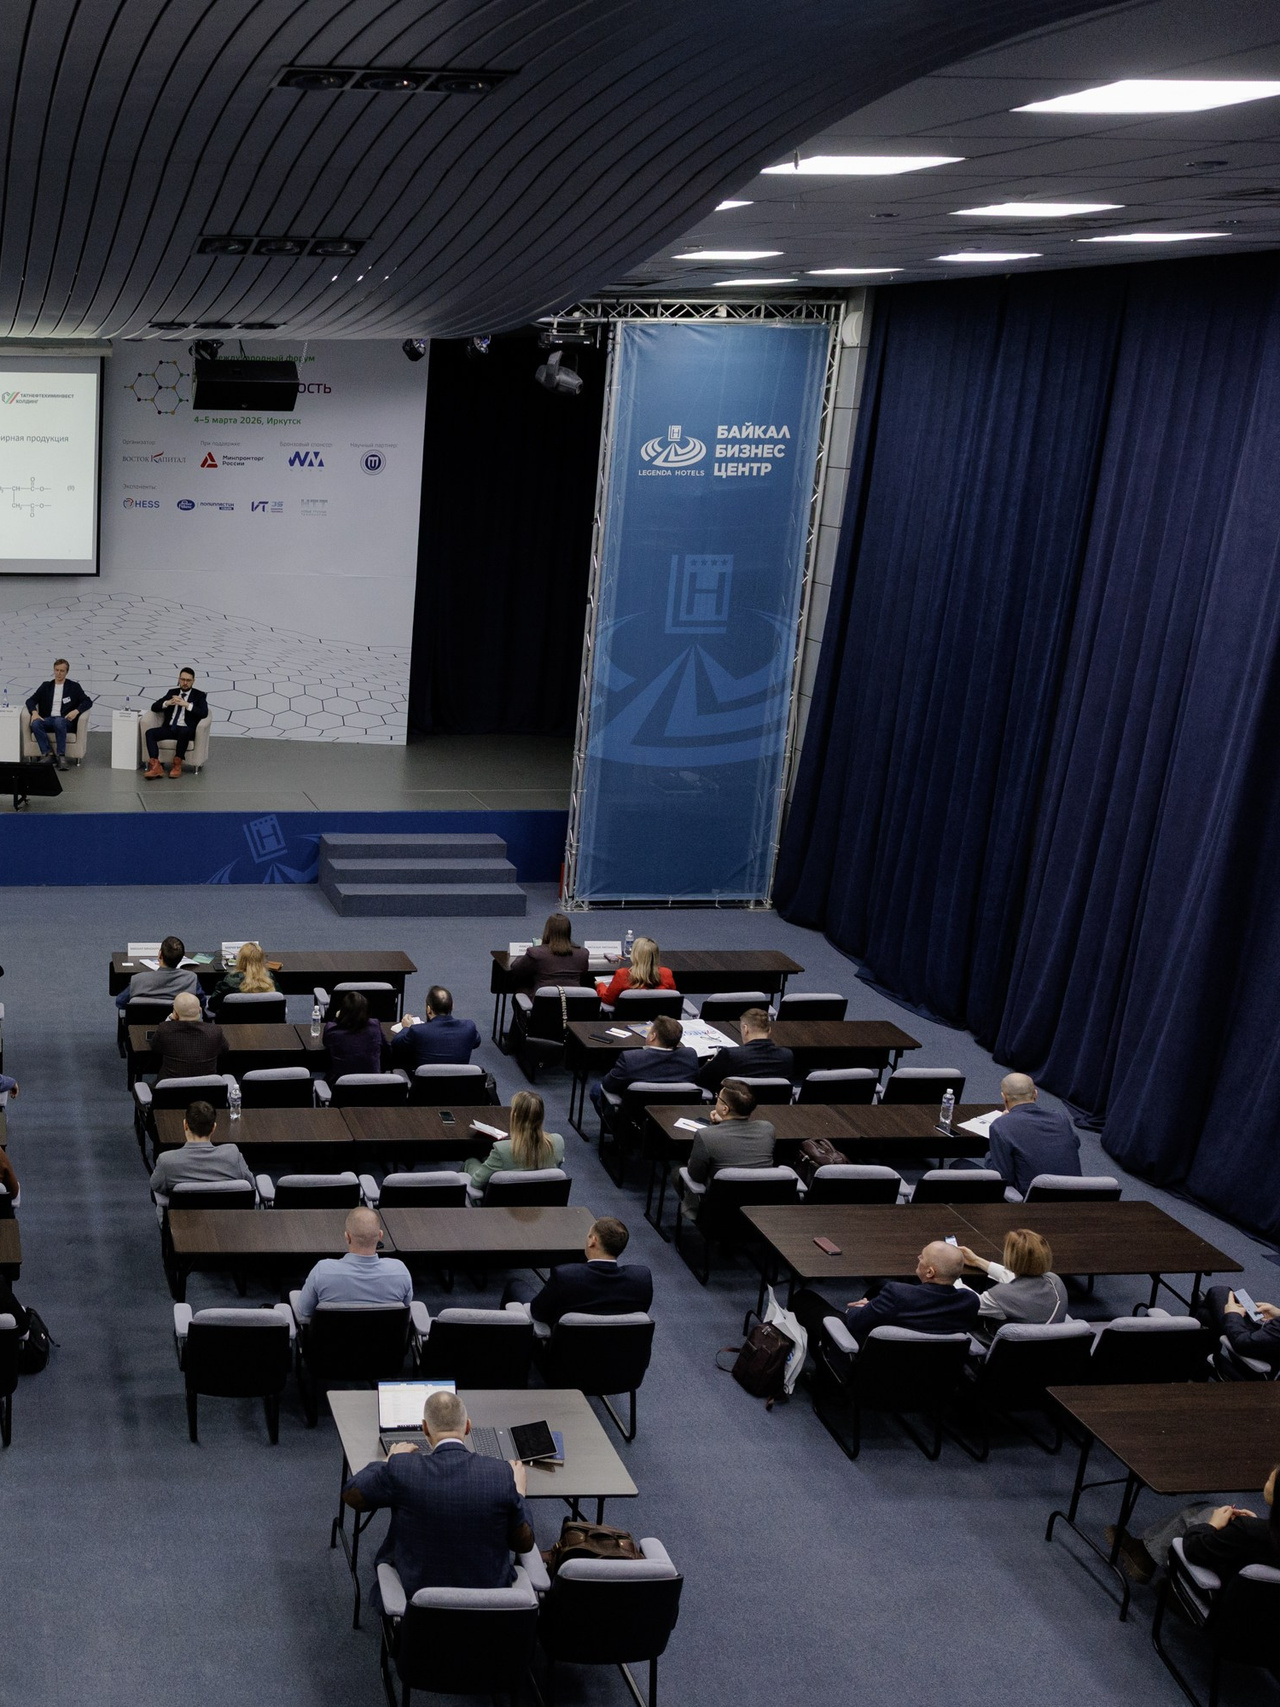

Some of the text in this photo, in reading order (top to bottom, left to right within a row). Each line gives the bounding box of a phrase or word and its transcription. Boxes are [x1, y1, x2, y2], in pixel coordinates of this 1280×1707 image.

[212, 417, 237, 425] марта
[240, 416, 264, 425] 2026,
[267, 417, 301, 426] Иркутск
[717, 422, 790, 439] БАЙКАЛ
[26, 435, 69, 443] продукция
[715, 444, 786, 458] БИЗНЕС
[714, 462, 772, 478] ЦЕНТР
